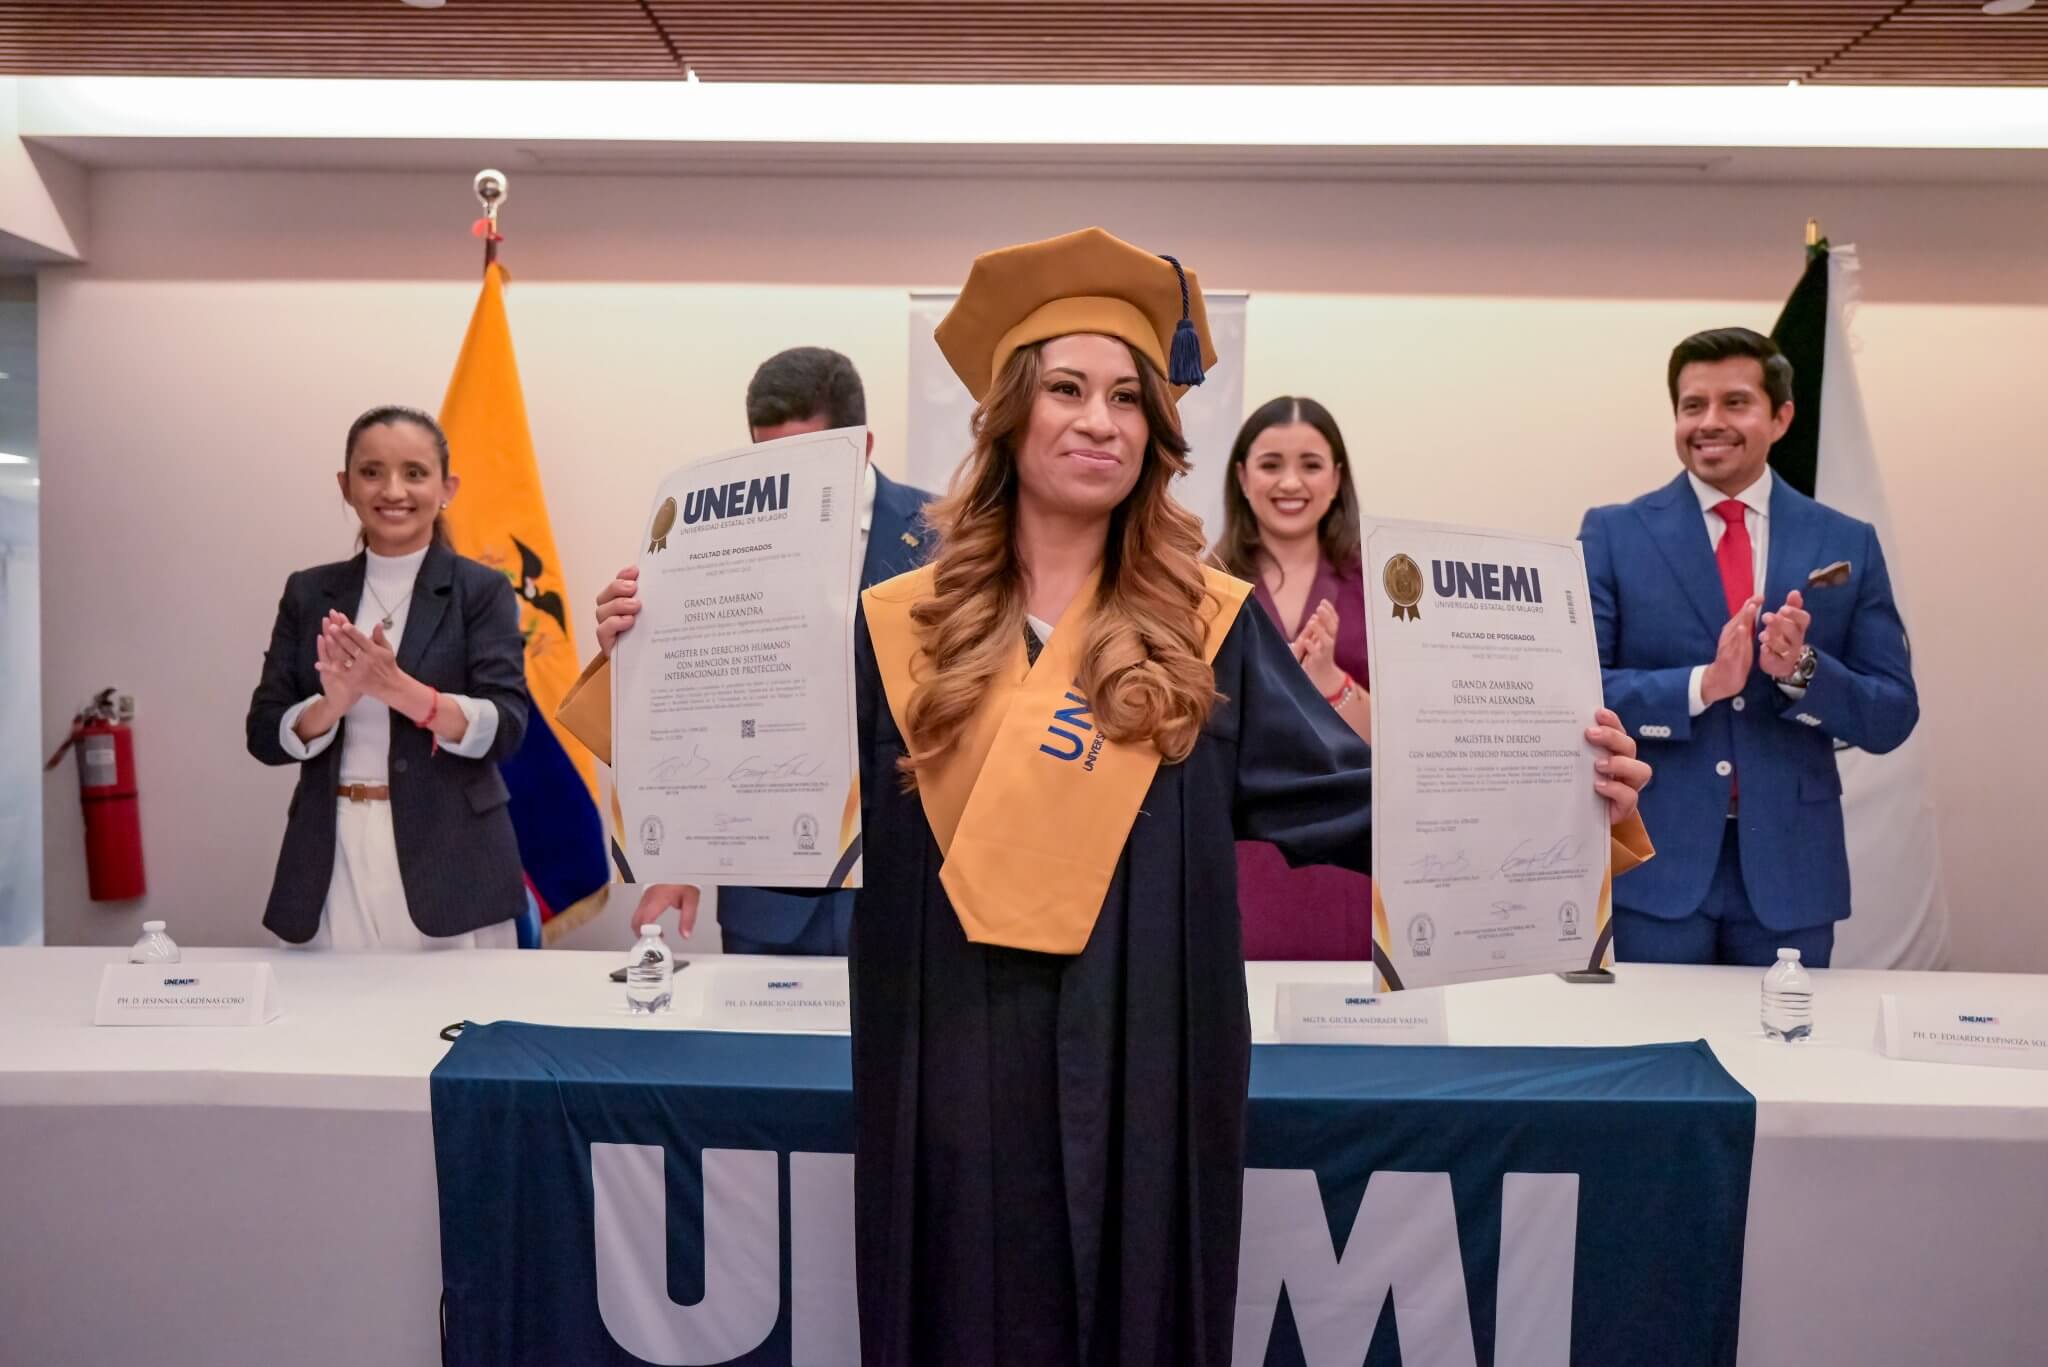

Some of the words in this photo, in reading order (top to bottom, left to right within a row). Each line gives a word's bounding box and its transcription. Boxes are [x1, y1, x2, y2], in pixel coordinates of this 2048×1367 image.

[683, 473, 790, 524] UNEMI
[680, 523, 719, 535] UNIVERSIDAD
[720, 519, 745, 529] ESTATAL
[747, 517, 756, 526] DE
[758, 512, 788, 524] MILAGRO
[689, 550, 721, 560] FACULTAD
[732, 543, 772, 555] POSGRADOS
[1432, 560, 1543, 603] UNEMI
[684, 596, 717, 609] GRANDA
[719, 591, 764, 605] ZAMBRANO
[684, 611, 716, 624] JOSELYN
[718, 605, 764, 619] ALEXANDRA
[1434, 601, 1478, 610] UNIVERSIDAD
[1480, 602, 1506, 612] ESTATAL
[1506, 604, 1515, 612] DE
[1516, 605, 1544, 614] MILAGRO
[1451, 631, 1485, 640] FACULTAD
[1496, 633, 1535, 642] POSGRADOS
[700, 648, 709, 657] EN
[711, 645, 749, 656] DERECHOS
[751, 640, 791, 651] HUMANOS
[676, 661, 692, 670] CON
[732, 656, 741, 665] EN
[743, 654, 777, 665] SISTEMAS
[664, 668, 728, 680] INTERNACIONALES
[1451, 680, 1487, 690] GRANDA
[1489, 680, 1534, 691] ZAMBRANO
[1453, 695, 1487, 705] JOSELYN
[1489, 696, 1536, 705] ALEXANDRA
[1494, 735, 1504, 744] EN
[1506, 735, 1541, 744] DERECHO
[1958, 1015, 1986, 1023] UNEMI
[1941, 1032, 1984, 1043] EDUARDO
